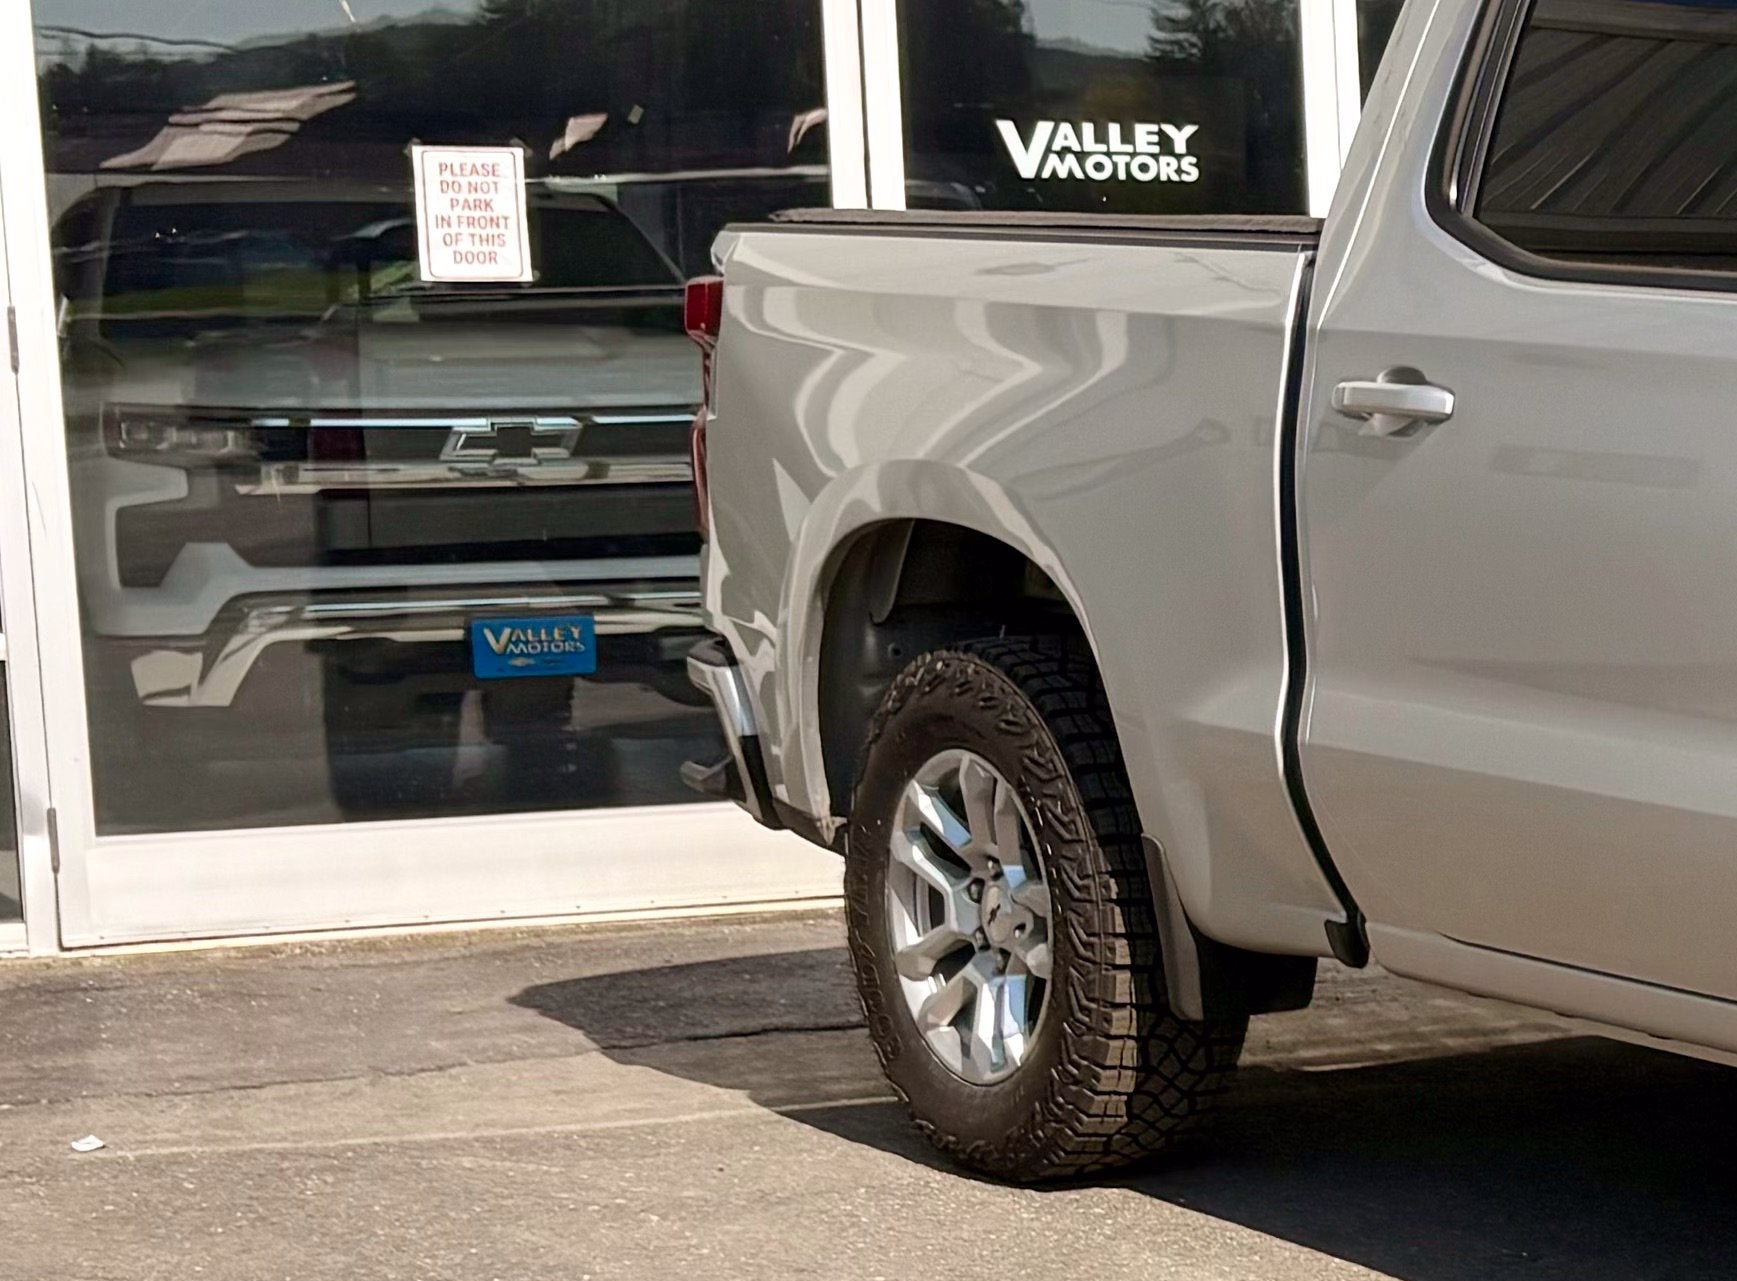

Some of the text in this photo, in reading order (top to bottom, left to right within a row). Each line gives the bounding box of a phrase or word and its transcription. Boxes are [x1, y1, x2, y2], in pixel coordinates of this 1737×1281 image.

[995, 119, 1200, 179] VALLEY
[438, 162, 501, 178] PLEASE
[1041, 153, 1200, 183] MOTORS
[439, 180, 500, 195] DO NOT
[449, 197, 495, 213] PARK
[435, 214, 511, 230] IN FRONT
[442, 232, 507, 247] OF THIS
[453, 250, 499, 265] DOOR
[482, 624, 582, 655] VALLEY
